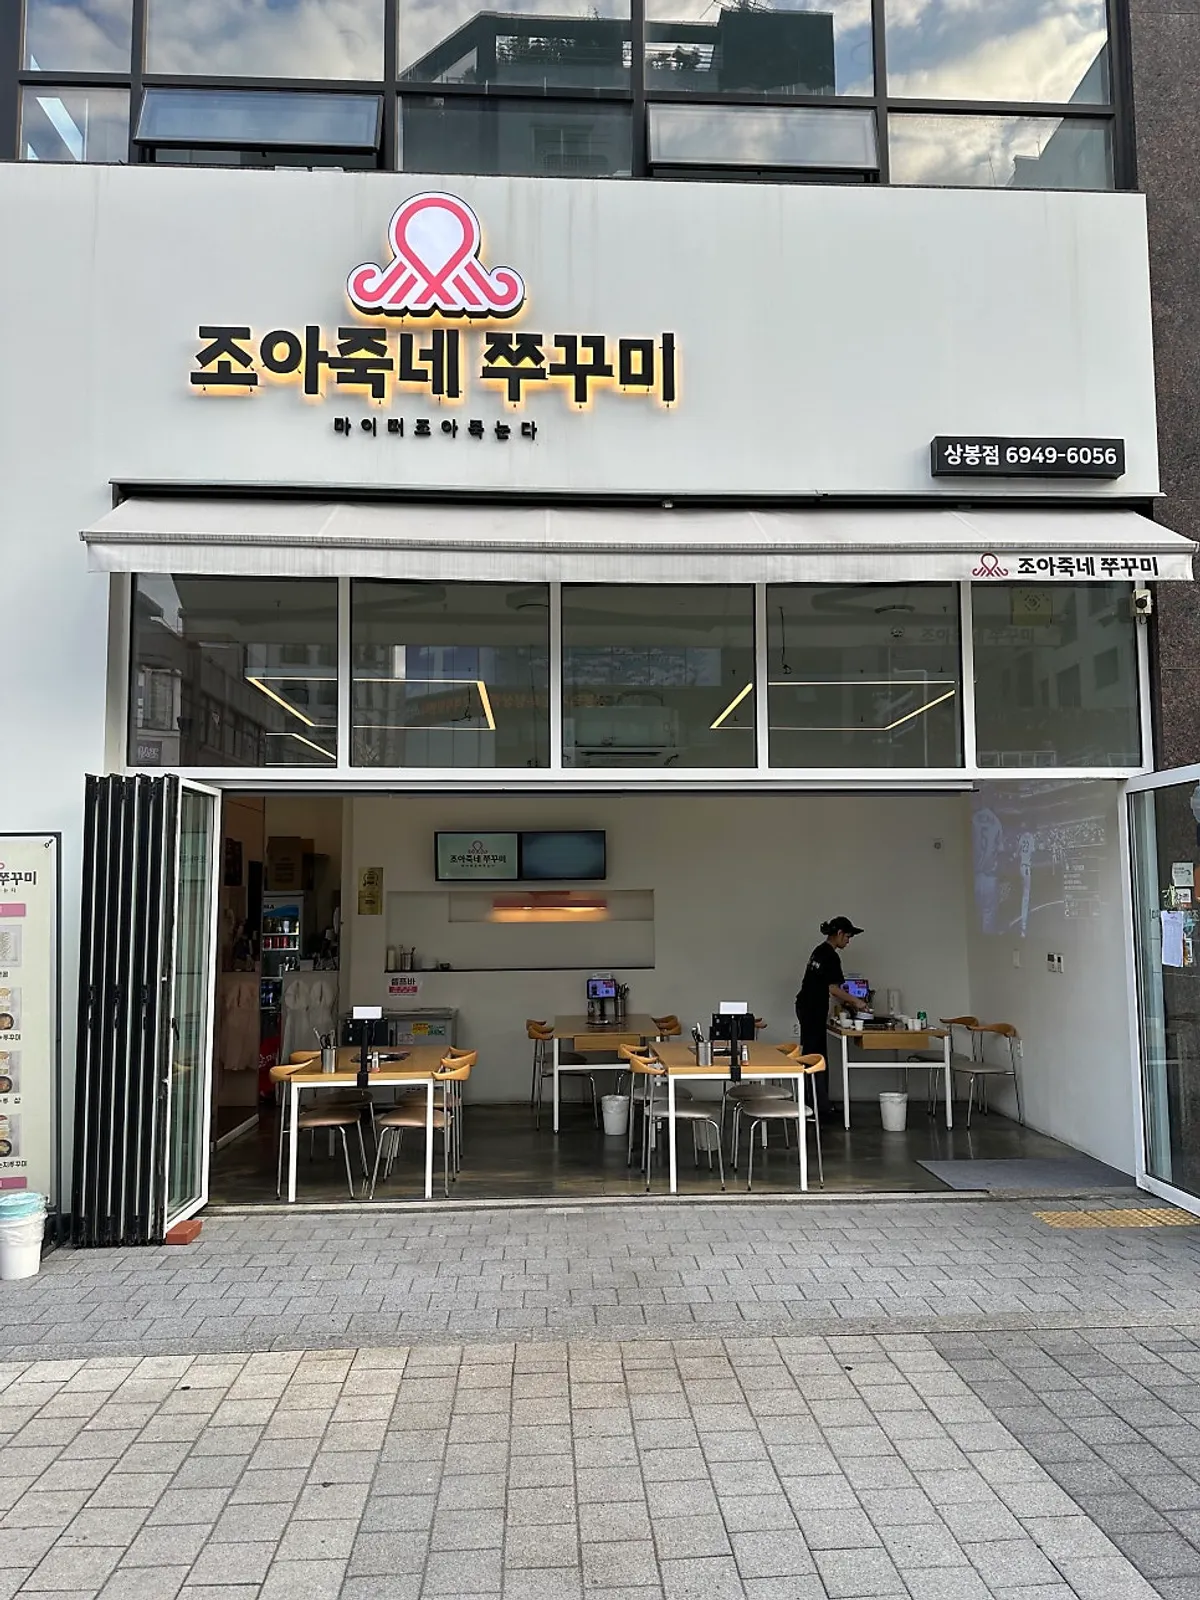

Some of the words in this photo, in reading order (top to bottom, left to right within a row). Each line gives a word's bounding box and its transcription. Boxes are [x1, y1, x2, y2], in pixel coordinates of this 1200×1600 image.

[190, 325, 462, 399] 조아죽네
[480, 332, 675, 403] 쭈꾸미
[943, 443, 1000, 466] 상봉점
[1006, 446, 1117, 465] 6949-6056
[1017, 556, 1095, 577] 조아죽네
[1100, 556, 1159, 577] 쭈꾸미
